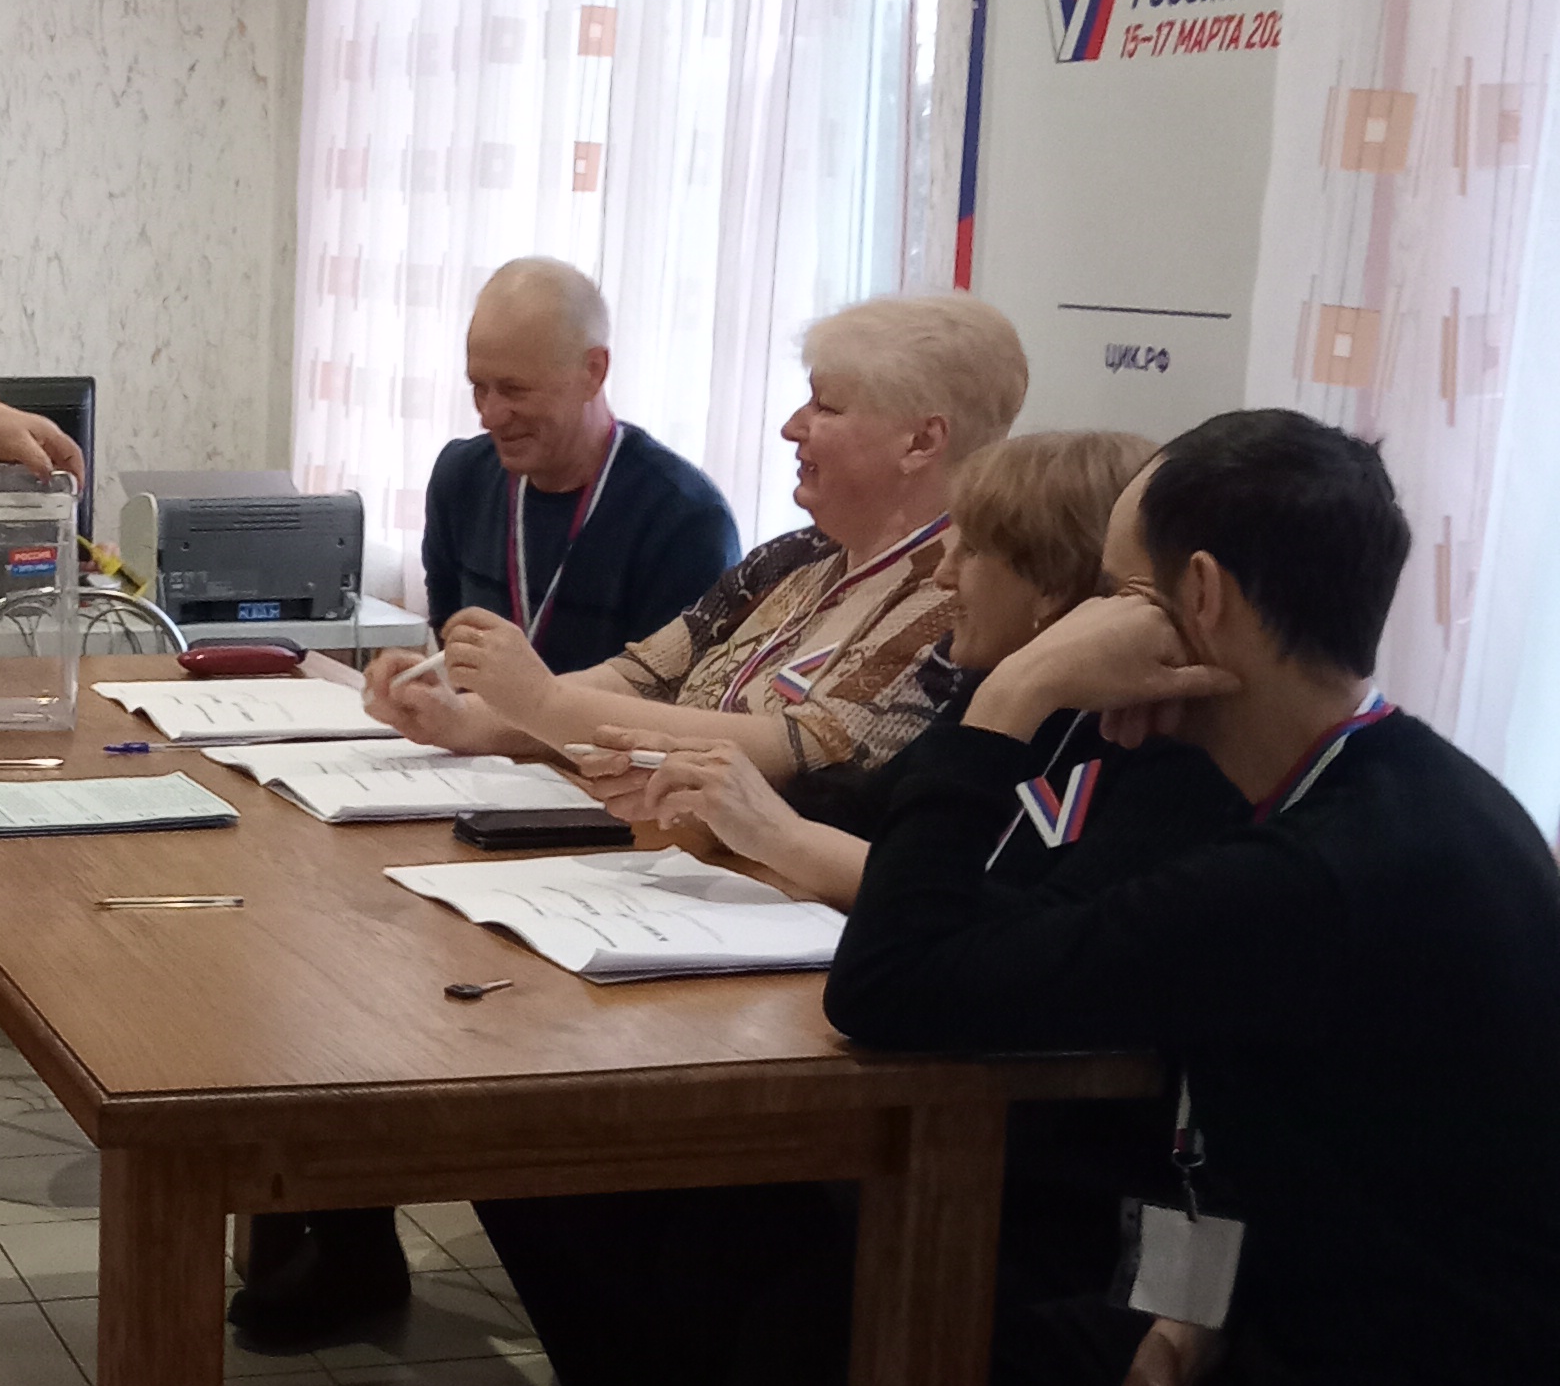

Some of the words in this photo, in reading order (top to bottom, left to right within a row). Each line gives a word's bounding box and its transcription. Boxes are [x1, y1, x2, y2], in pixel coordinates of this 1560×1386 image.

[1172, 13, 1245, 55] МАРТА
[1244, 9, 1285, 51] 202
[1104, 342, 1171, 374] ЦИК.РФ
